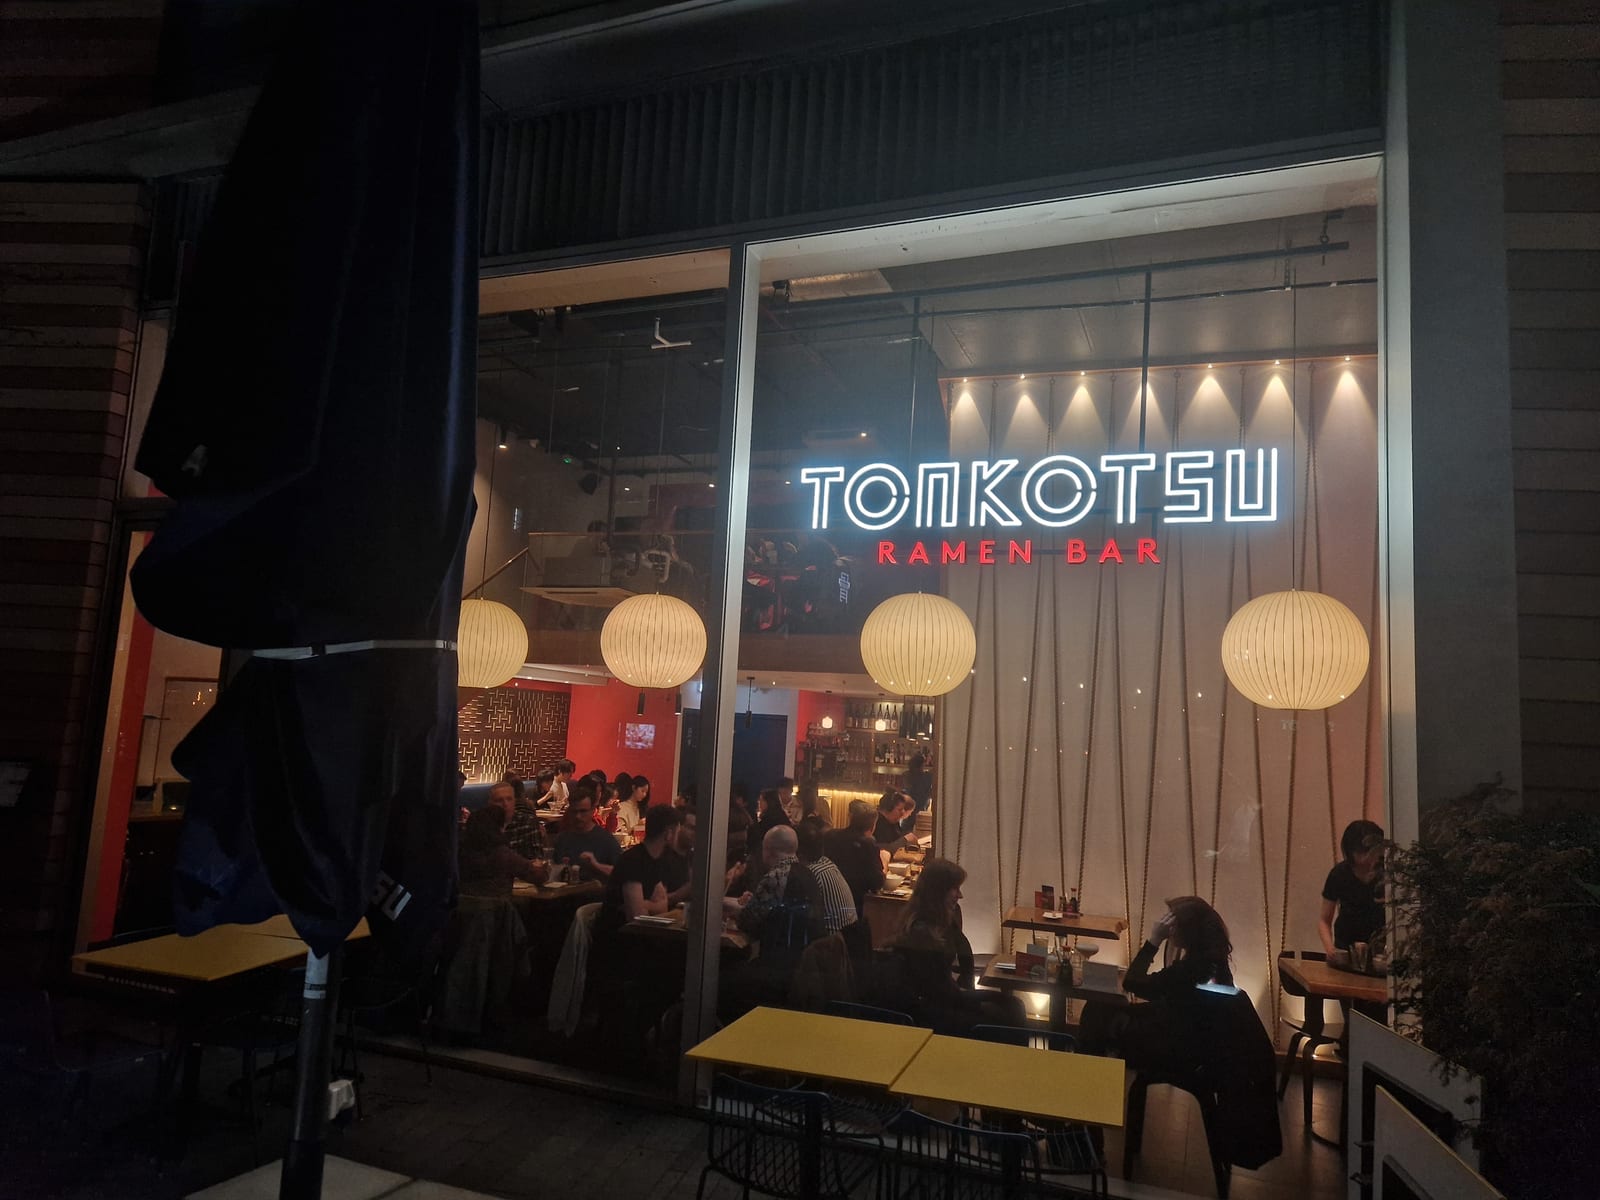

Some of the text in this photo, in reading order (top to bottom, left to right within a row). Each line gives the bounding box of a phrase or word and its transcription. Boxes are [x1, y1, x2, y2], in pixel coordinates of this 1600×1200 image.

[800, 447, 1278, 531] TONKOTSU
[877, 537, 1161, 565] RAMEN BAR
